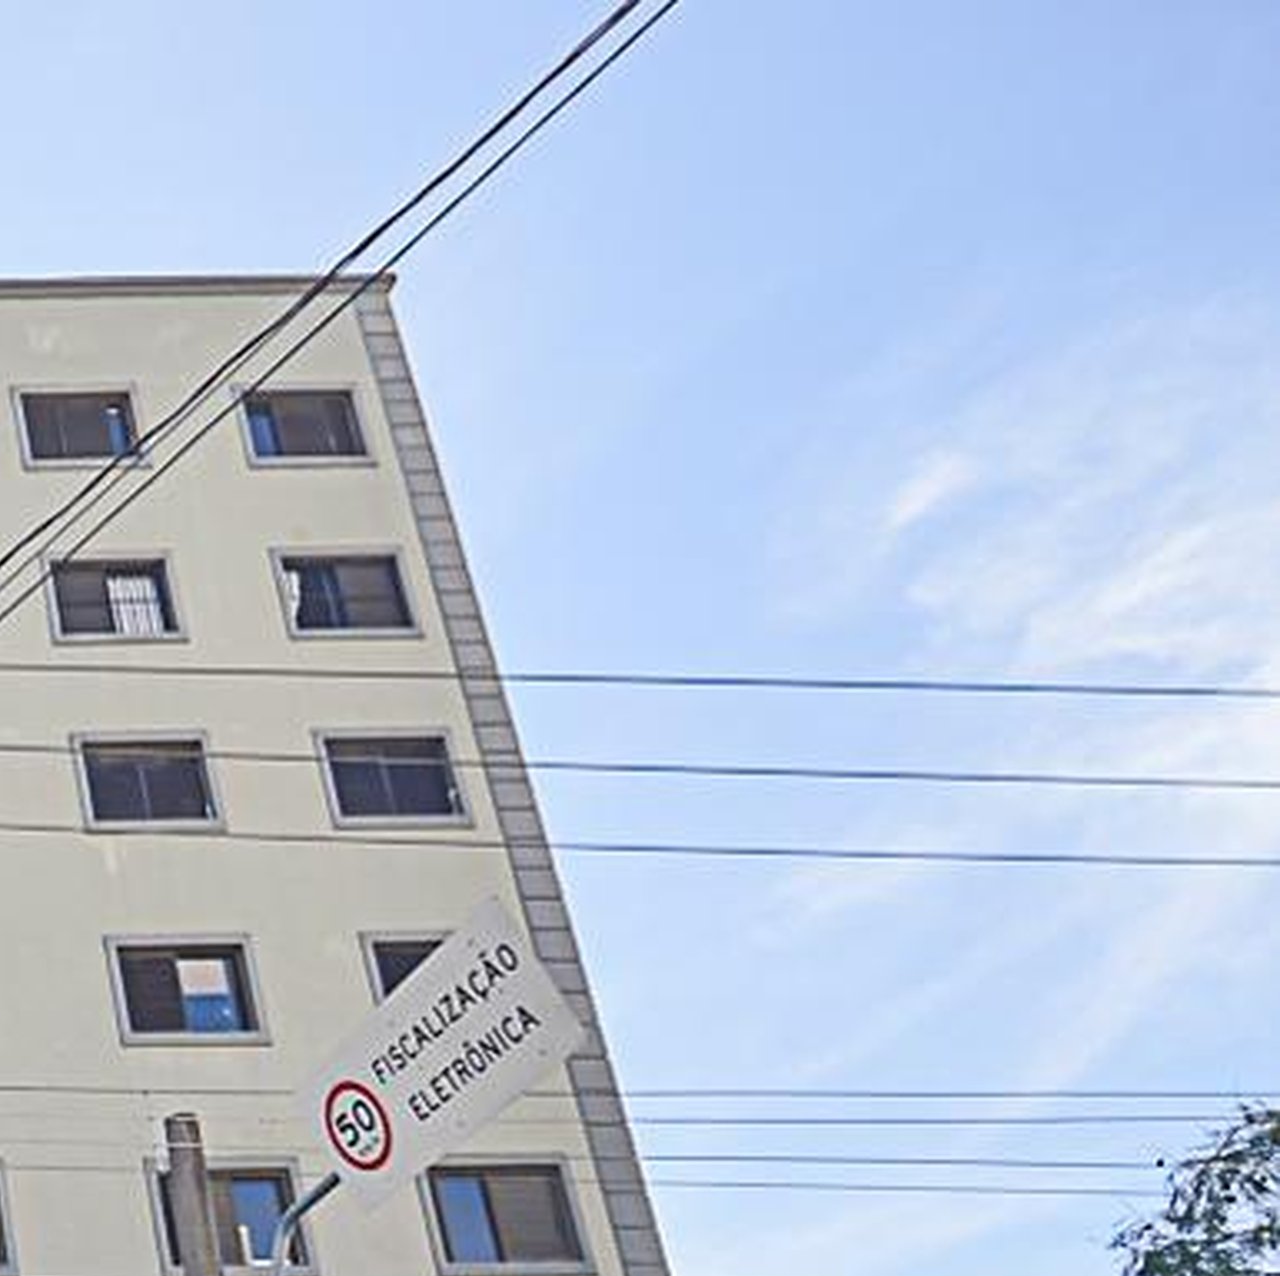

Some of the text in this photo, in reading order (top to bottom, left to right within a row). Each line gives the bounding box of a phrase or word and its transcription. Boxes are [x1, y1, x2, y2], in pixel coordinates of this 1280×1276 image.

[371, 942, 519, 1085] FISCALIZAÇÃO
[407, 1005, 542, 1123] ELETRÔNICA
[335, 1099, 376, 1148] 50
